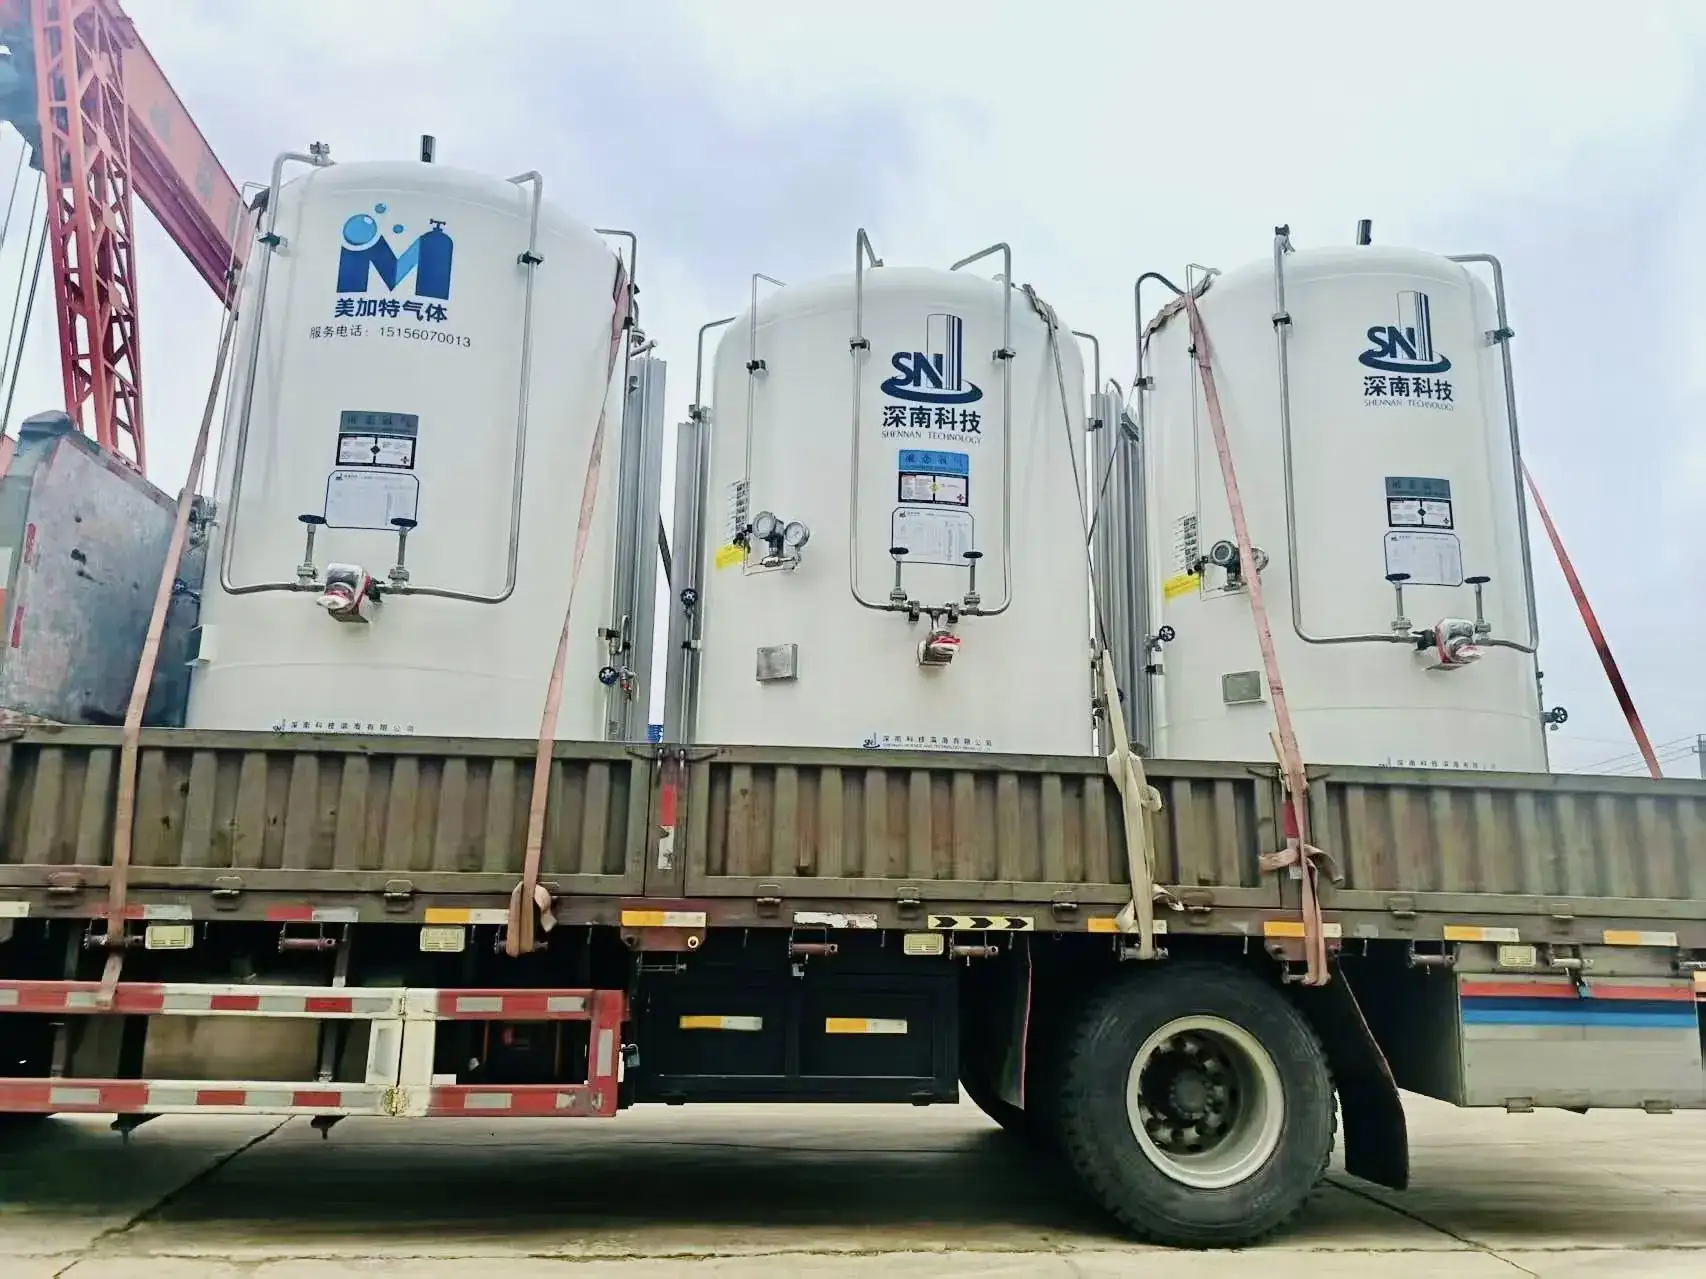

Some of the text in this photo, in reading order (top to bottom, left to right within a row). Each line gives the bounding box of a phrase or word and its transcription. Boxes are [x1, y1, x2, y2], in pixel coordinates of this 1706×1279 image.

[334, 297, 448, 323] 美加特气体
[379, 326, 471, 348] 15156070013
[1363, 375, 1453, 402] 深南科技
[1364, 398, 1454, 411] SHENNAN TECHNOLOGY
[882, 405, 981, 434] 深南科技
[882, 430, 982, 444] SHENNAN TECHNOLOGY
